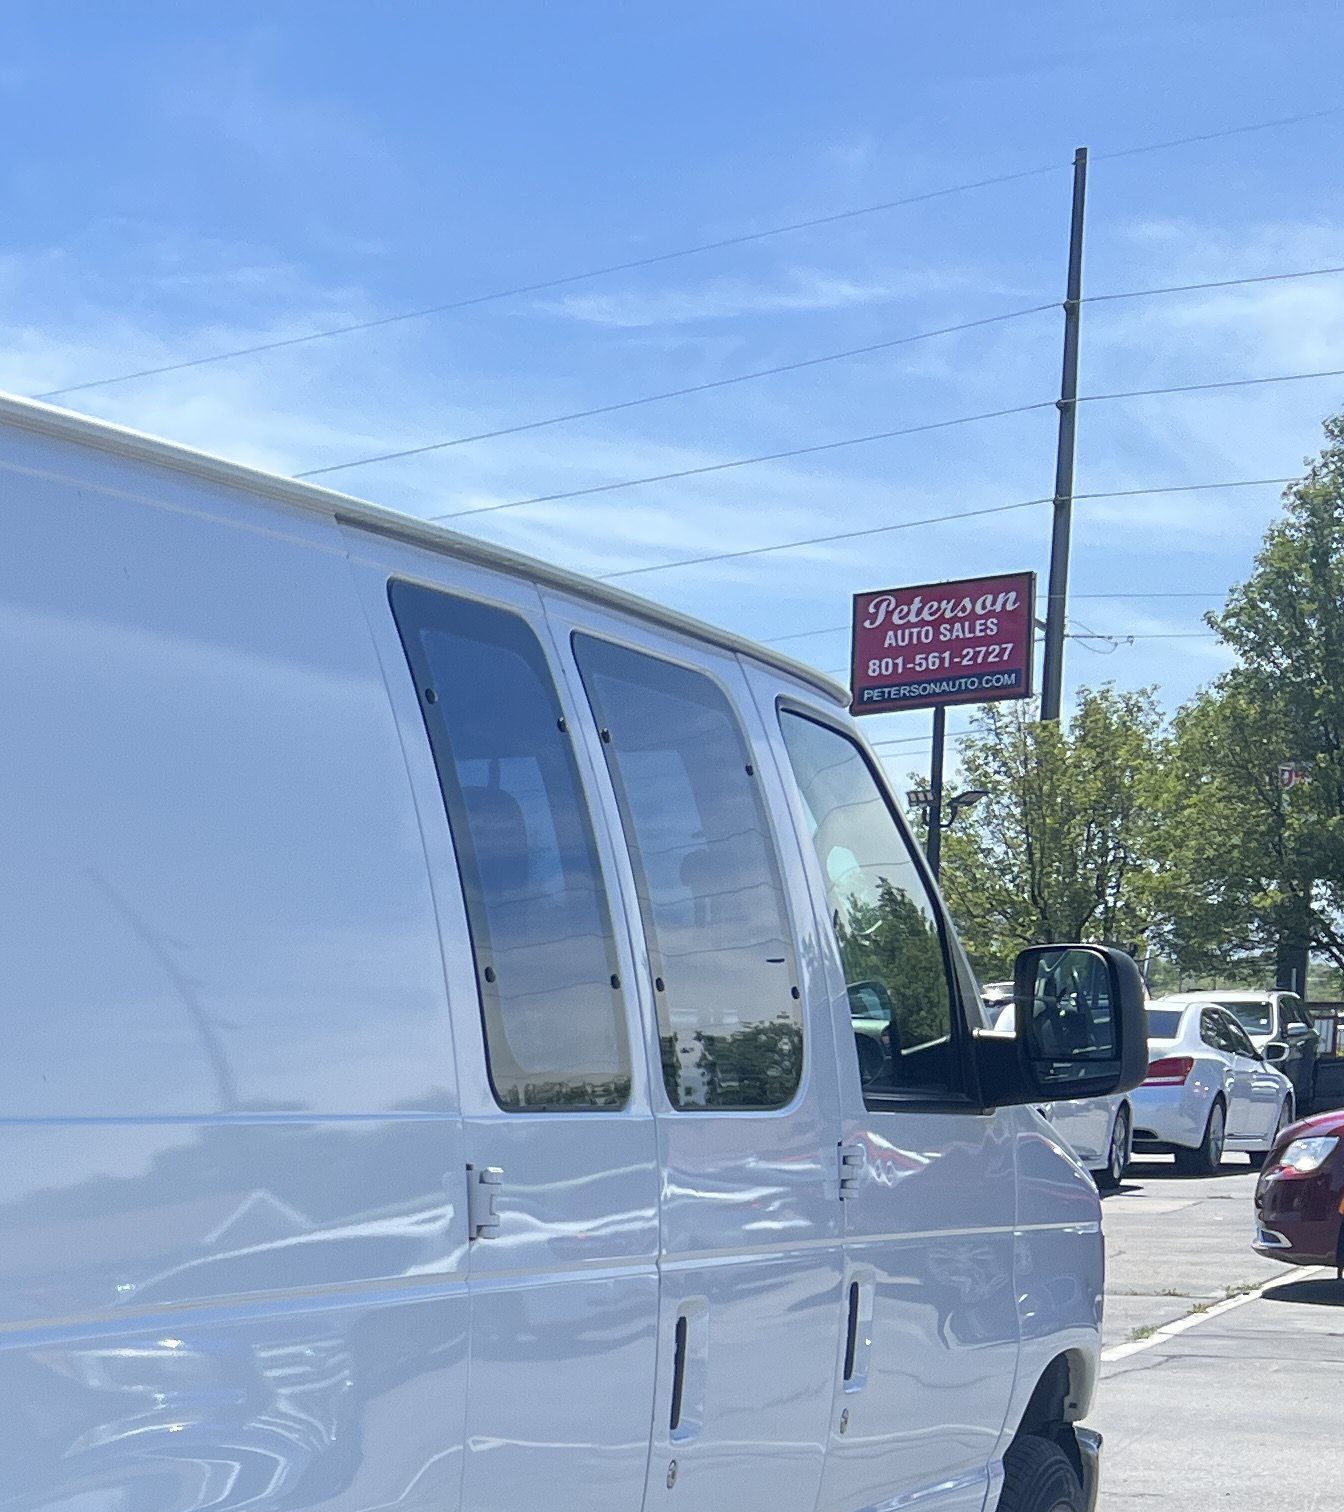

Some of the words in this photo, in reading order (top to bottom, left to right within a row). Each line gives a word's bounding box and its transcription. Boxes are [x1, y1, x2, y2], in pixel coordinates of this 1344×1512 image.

[863, 590, 1021, 629] Peterson
[883, 625, 933, 648] AUTO
[939, 618, 999, 640] SALES
[867, 643, 1014, 677] 801-561-2727
[863, 673, 1016, 702] PETERSONAUTO.COM
